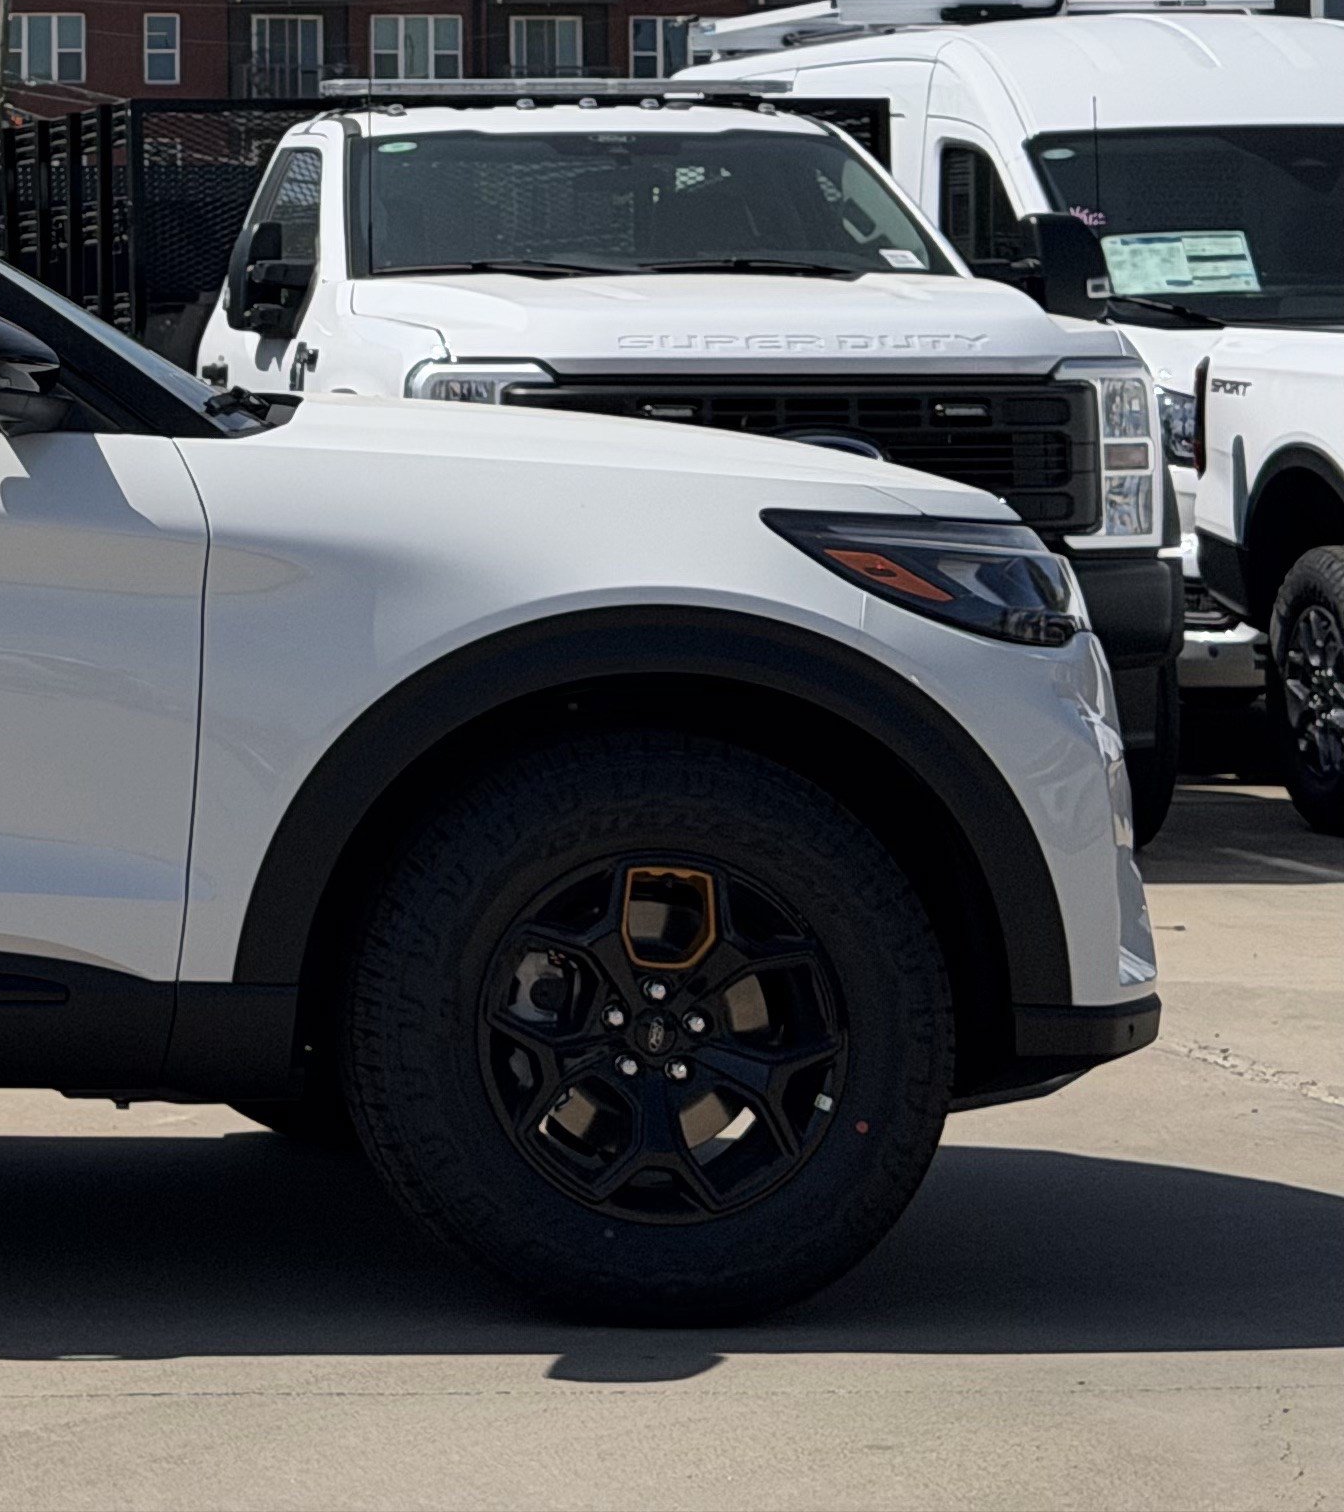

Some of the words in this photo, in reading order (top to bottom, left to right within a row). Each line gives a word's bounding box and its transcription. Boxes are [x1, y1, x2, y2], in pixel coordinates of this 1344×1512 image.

[617, 333, 825, 351] SUPER
[834, 332, 990, 351] DUTY
[1211, 378, 1253, 396] SPORT
